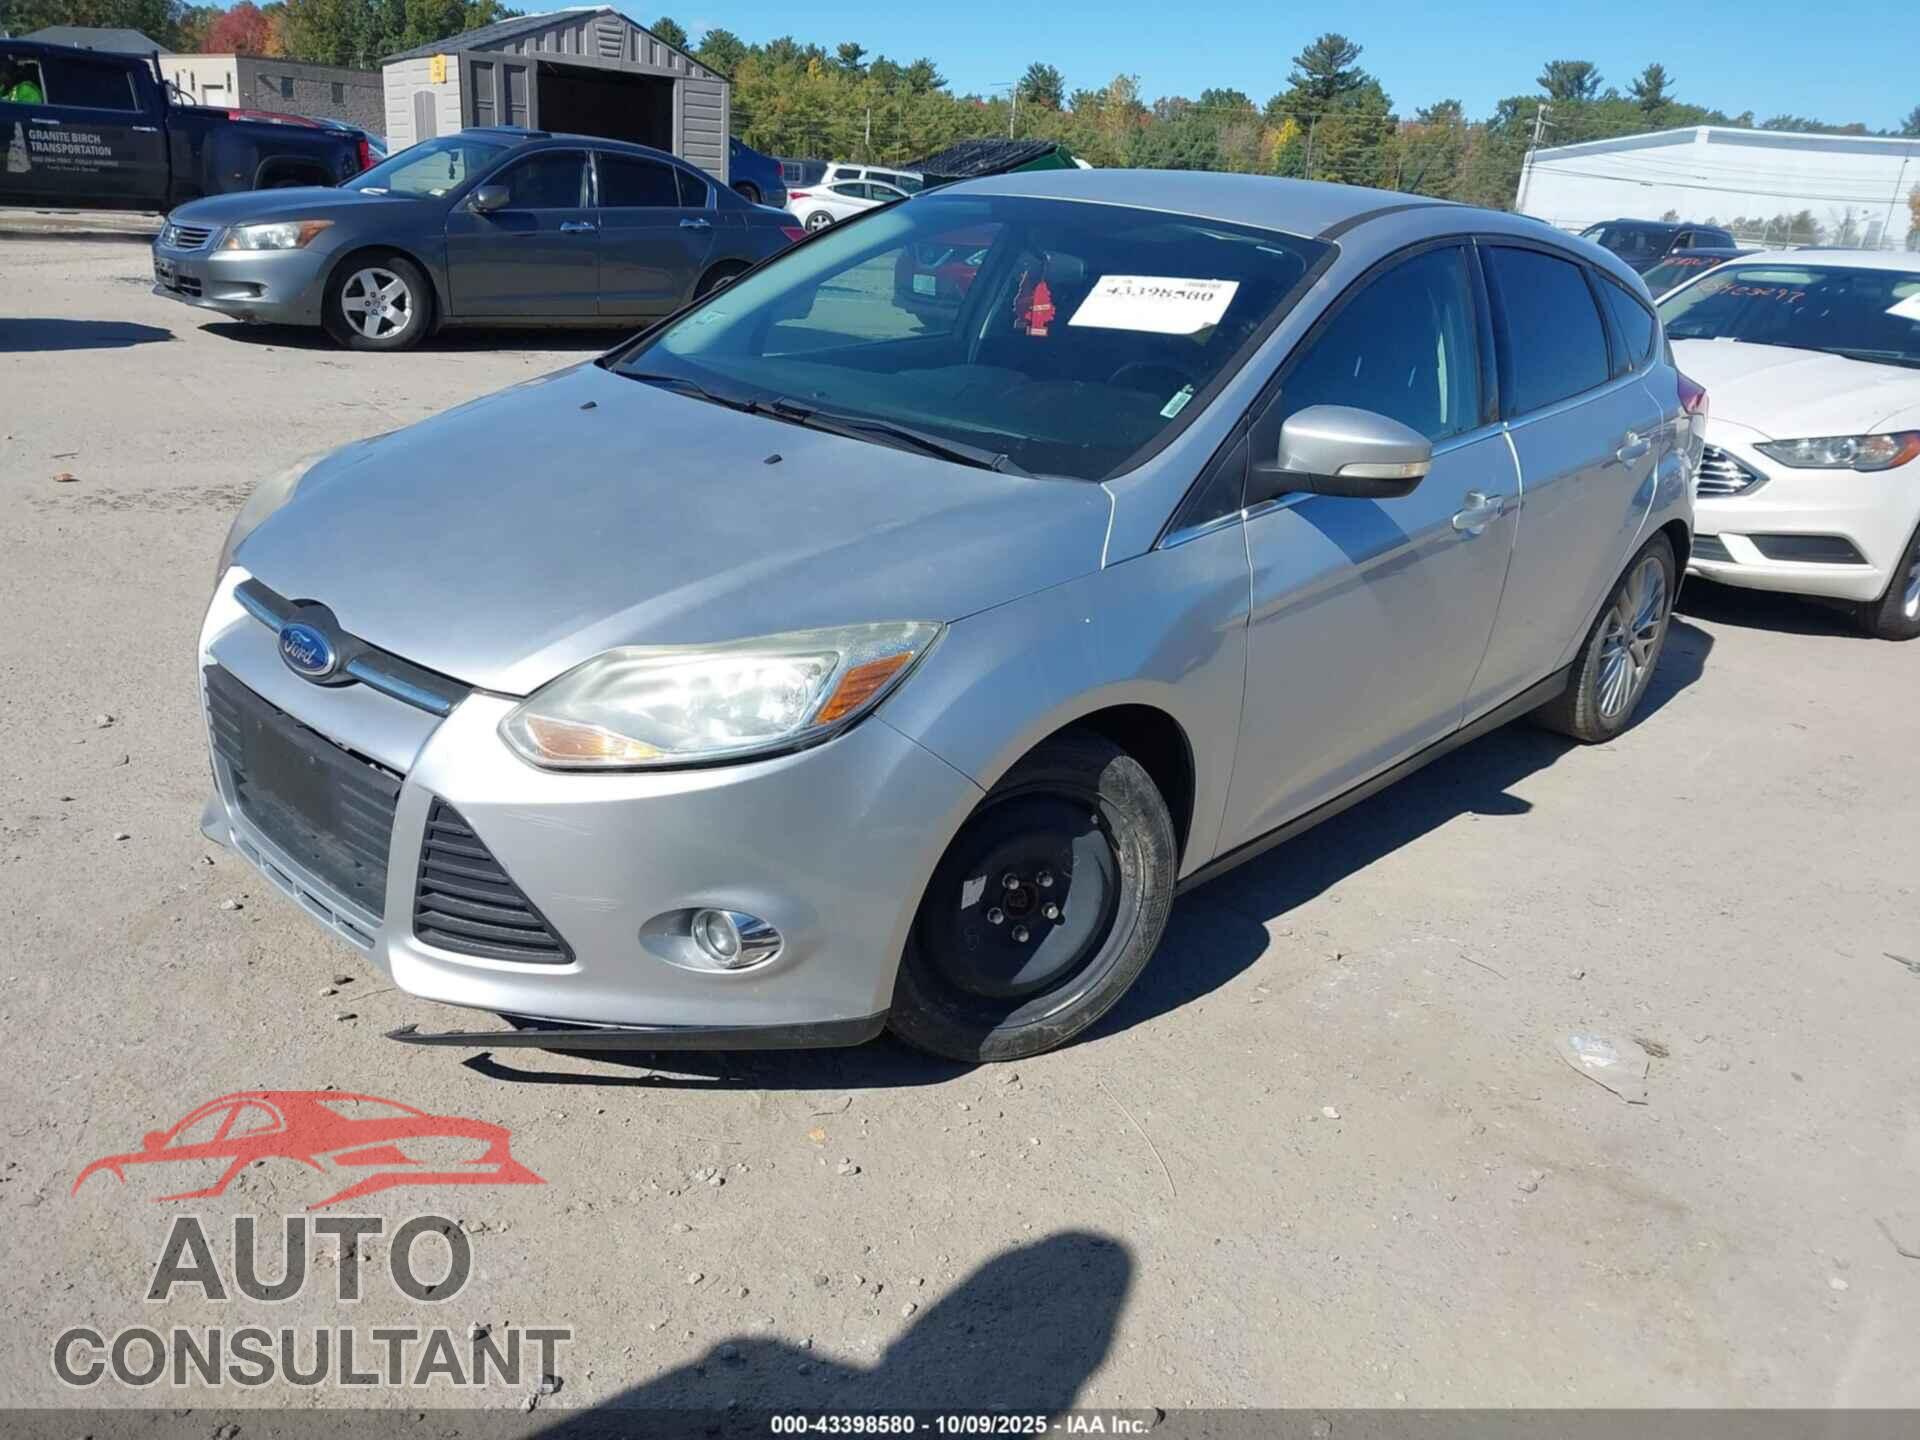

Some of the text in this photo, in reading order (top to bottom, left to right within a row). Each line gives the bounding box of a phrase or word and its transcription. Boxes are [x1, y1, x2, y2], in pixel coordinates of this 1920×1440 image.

[29, 129, 101, 144] GRANITE BIRCH
[31, 141, 111, 155] TRANSPORTATION
[285, 631, 316, 664] Ford
